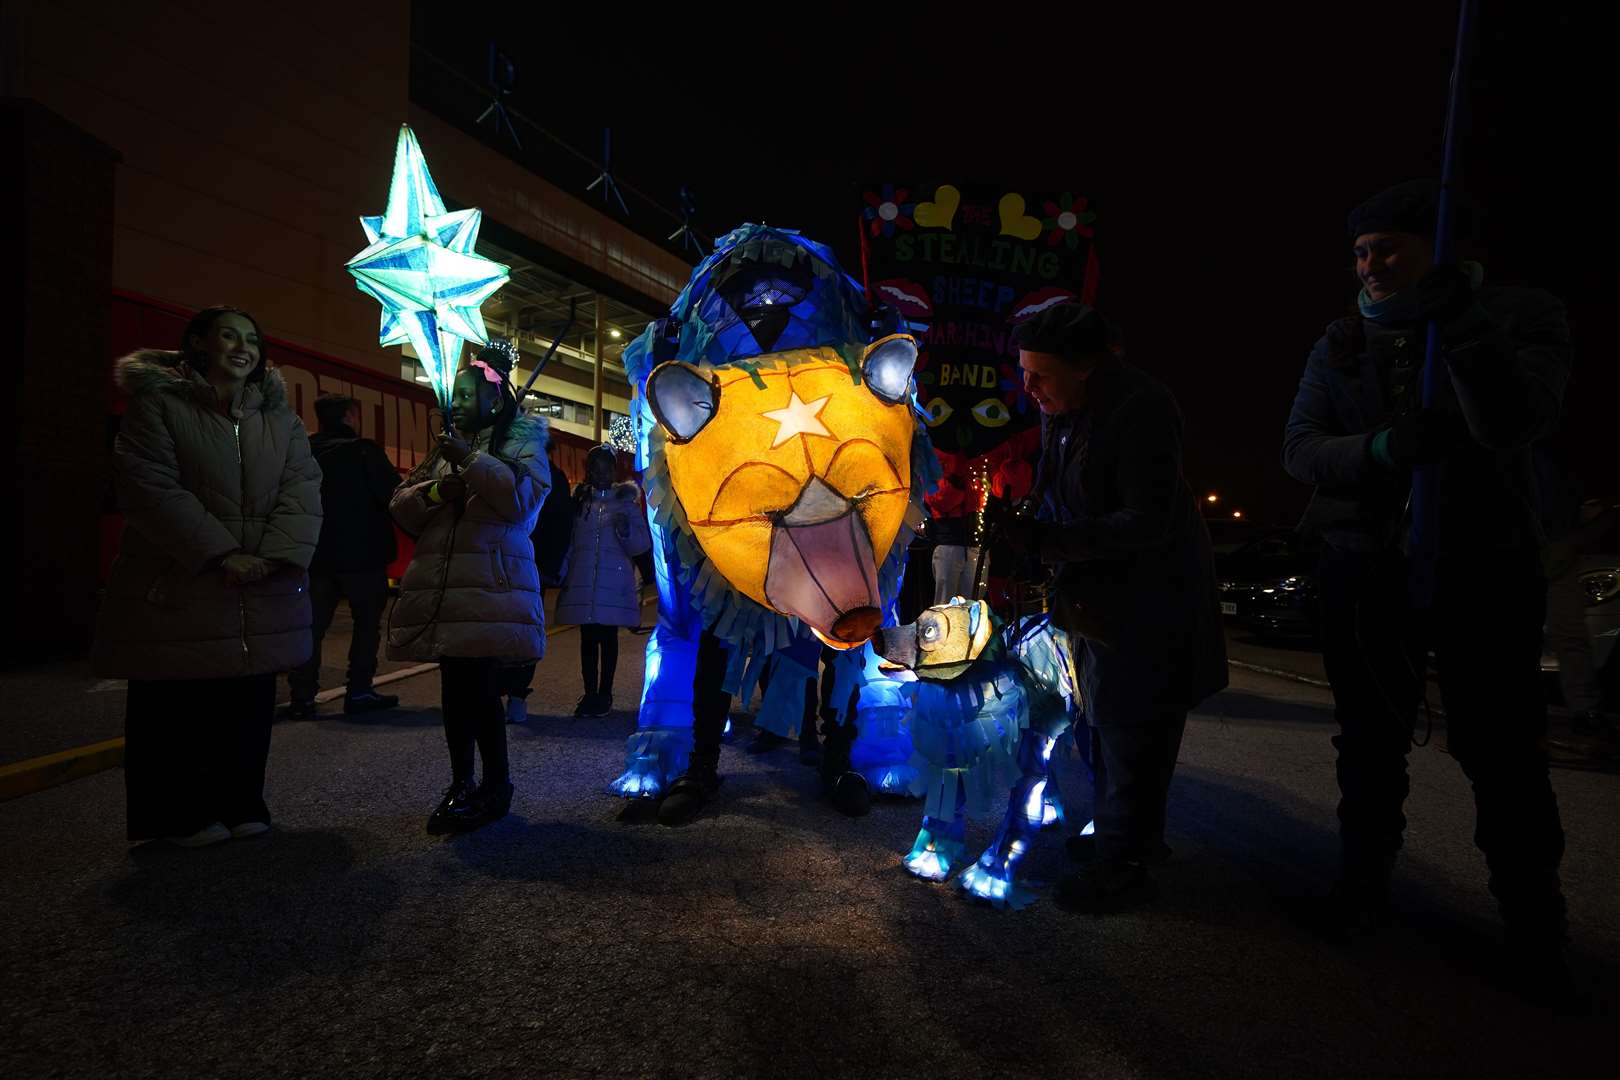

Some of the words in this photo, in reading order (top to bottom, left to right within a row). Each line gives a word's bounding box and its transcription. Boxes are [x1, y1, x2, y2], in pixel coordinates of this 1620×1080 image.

[896, 234, 1059, 279] STEALING
[931, 275, 1015, 312] SHEEP
[940, 363, 998, 388] BAND
